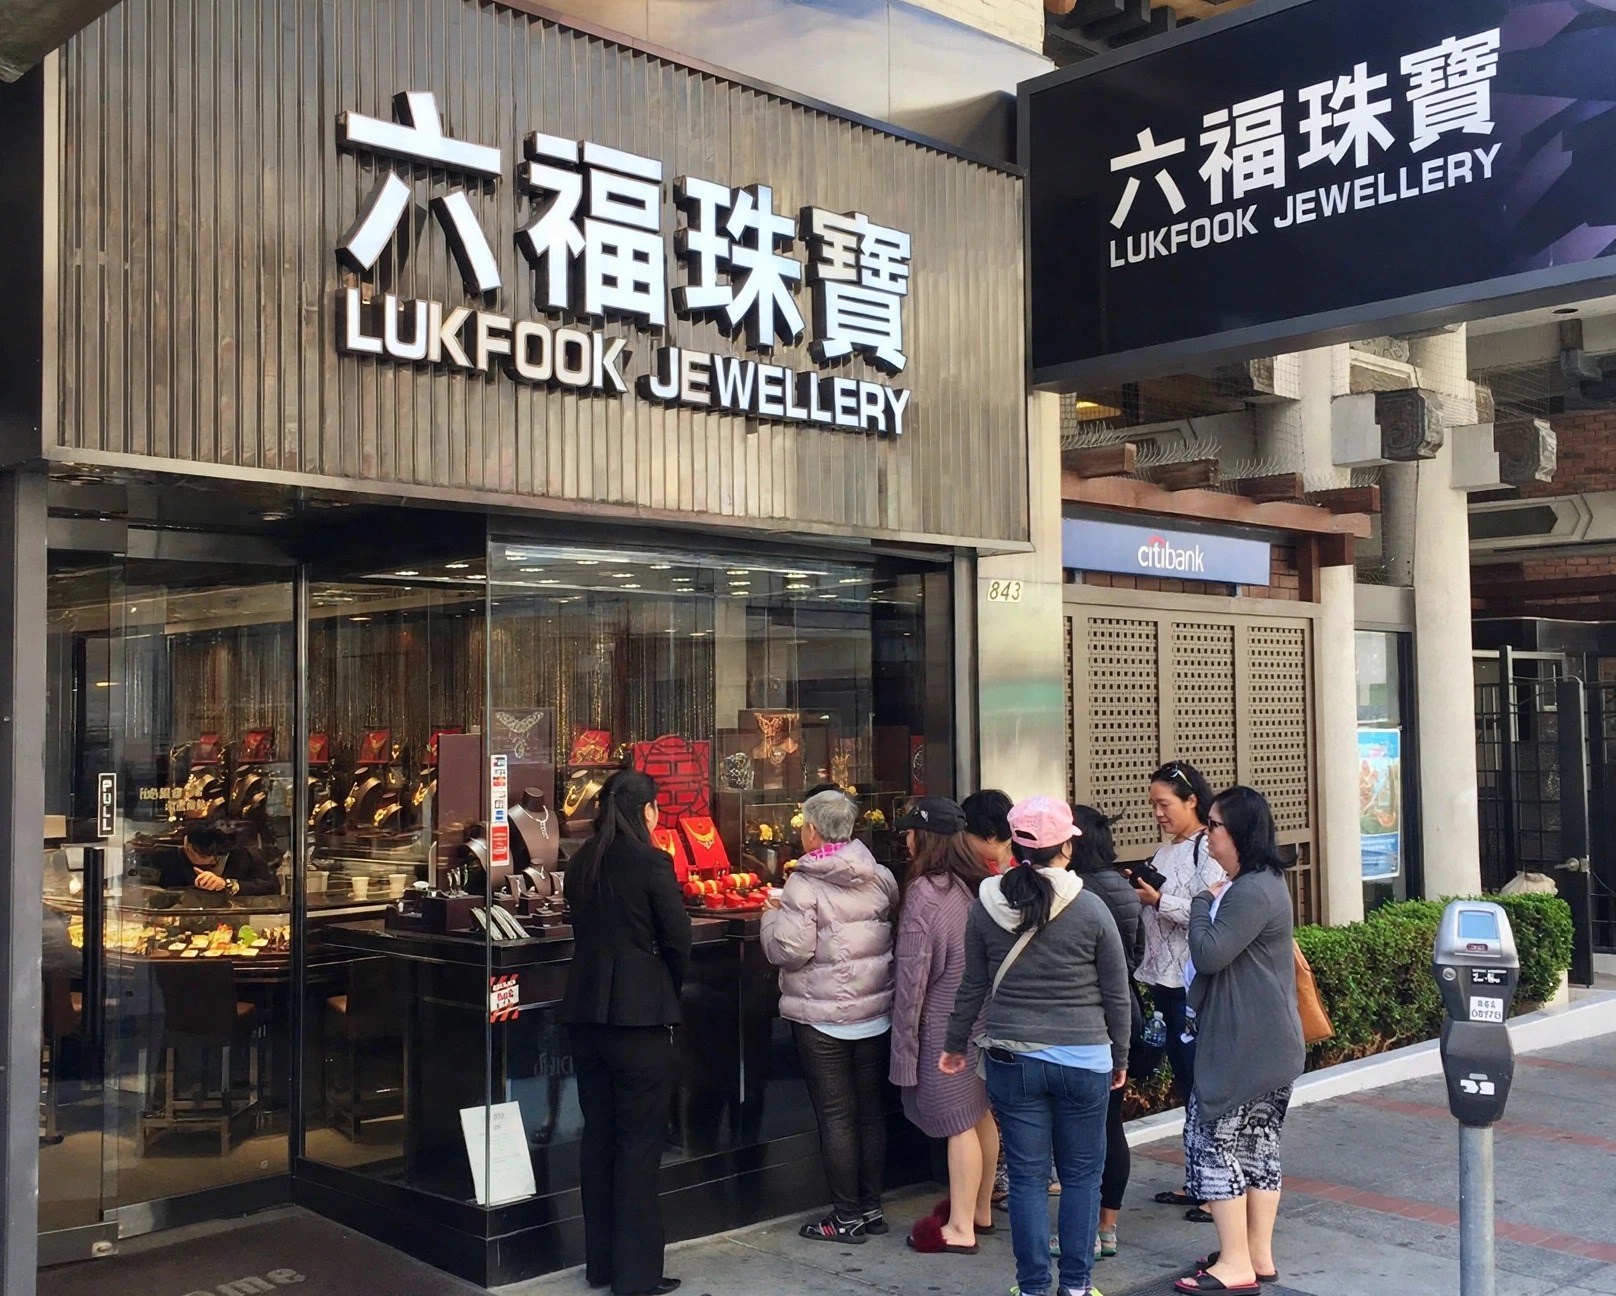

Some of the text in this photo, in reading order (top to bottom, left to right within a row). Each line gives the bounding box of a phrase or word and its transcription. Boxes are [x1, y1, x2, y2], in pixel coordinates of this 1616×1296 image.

[1110, 27, 1500, 230] 六福珠寶
[344, 91, 911, 374] 六福珠寶
[1110, 142, 1502, 268] LUKFOOK JEWELLERY
[343, 287, 911, 437] LUKFOOK JEWELLERY
[988, 580, 1022, 602] 843
[1137, 539, 1205, 573] citibank
[101, 779, 113, 831] PULL
